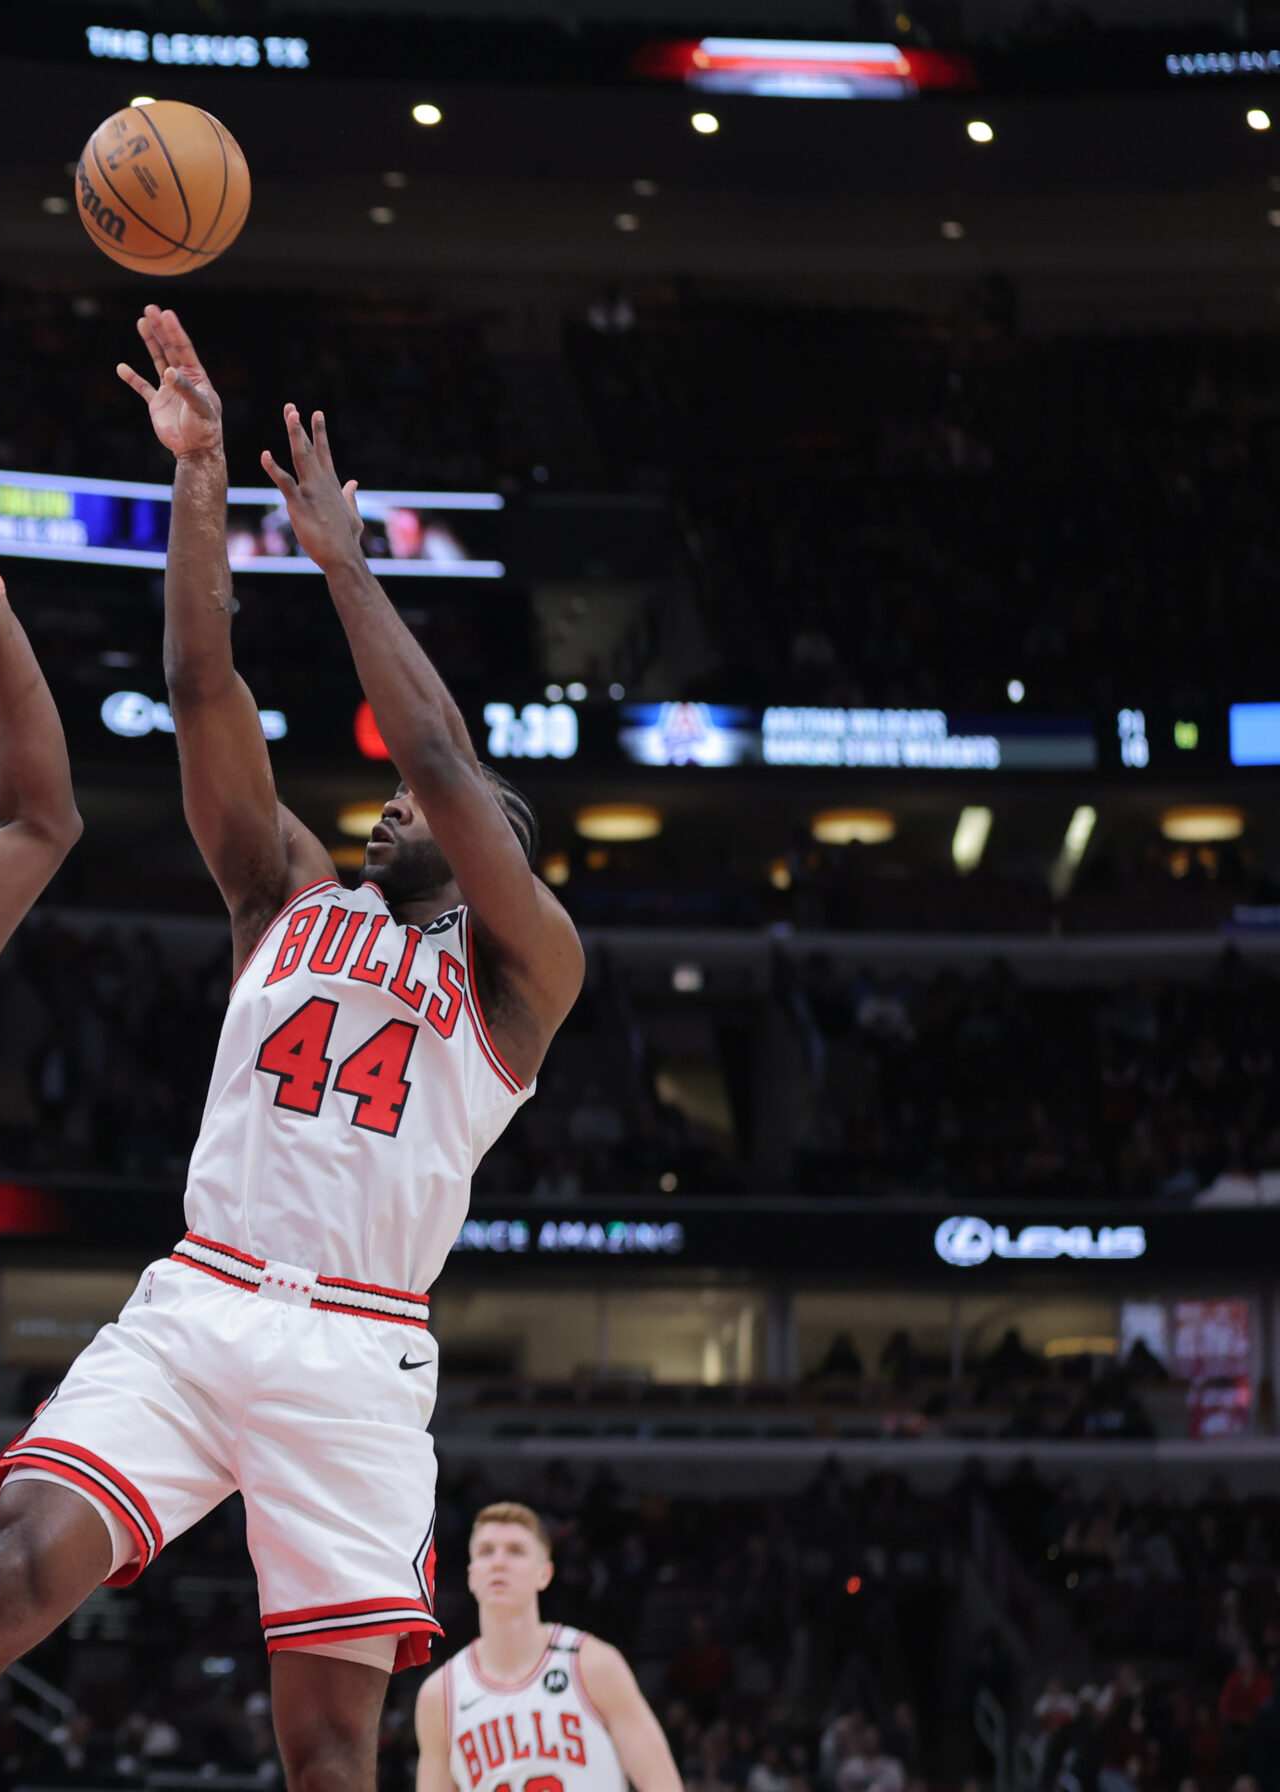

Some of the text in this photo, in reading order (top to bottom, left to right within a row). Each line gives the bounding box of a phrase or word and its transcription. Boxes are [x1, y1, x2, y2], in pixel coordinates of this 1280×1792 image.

[85, 25, 310, 69] THE LEXUS TX
[262, 904, 466, 1040] BULLS
[255, 995, 420, 1138] 44
[454, 1219, 686, 1254] NCE AMAZING
[458, 1710, 587, 1789] BULLS
